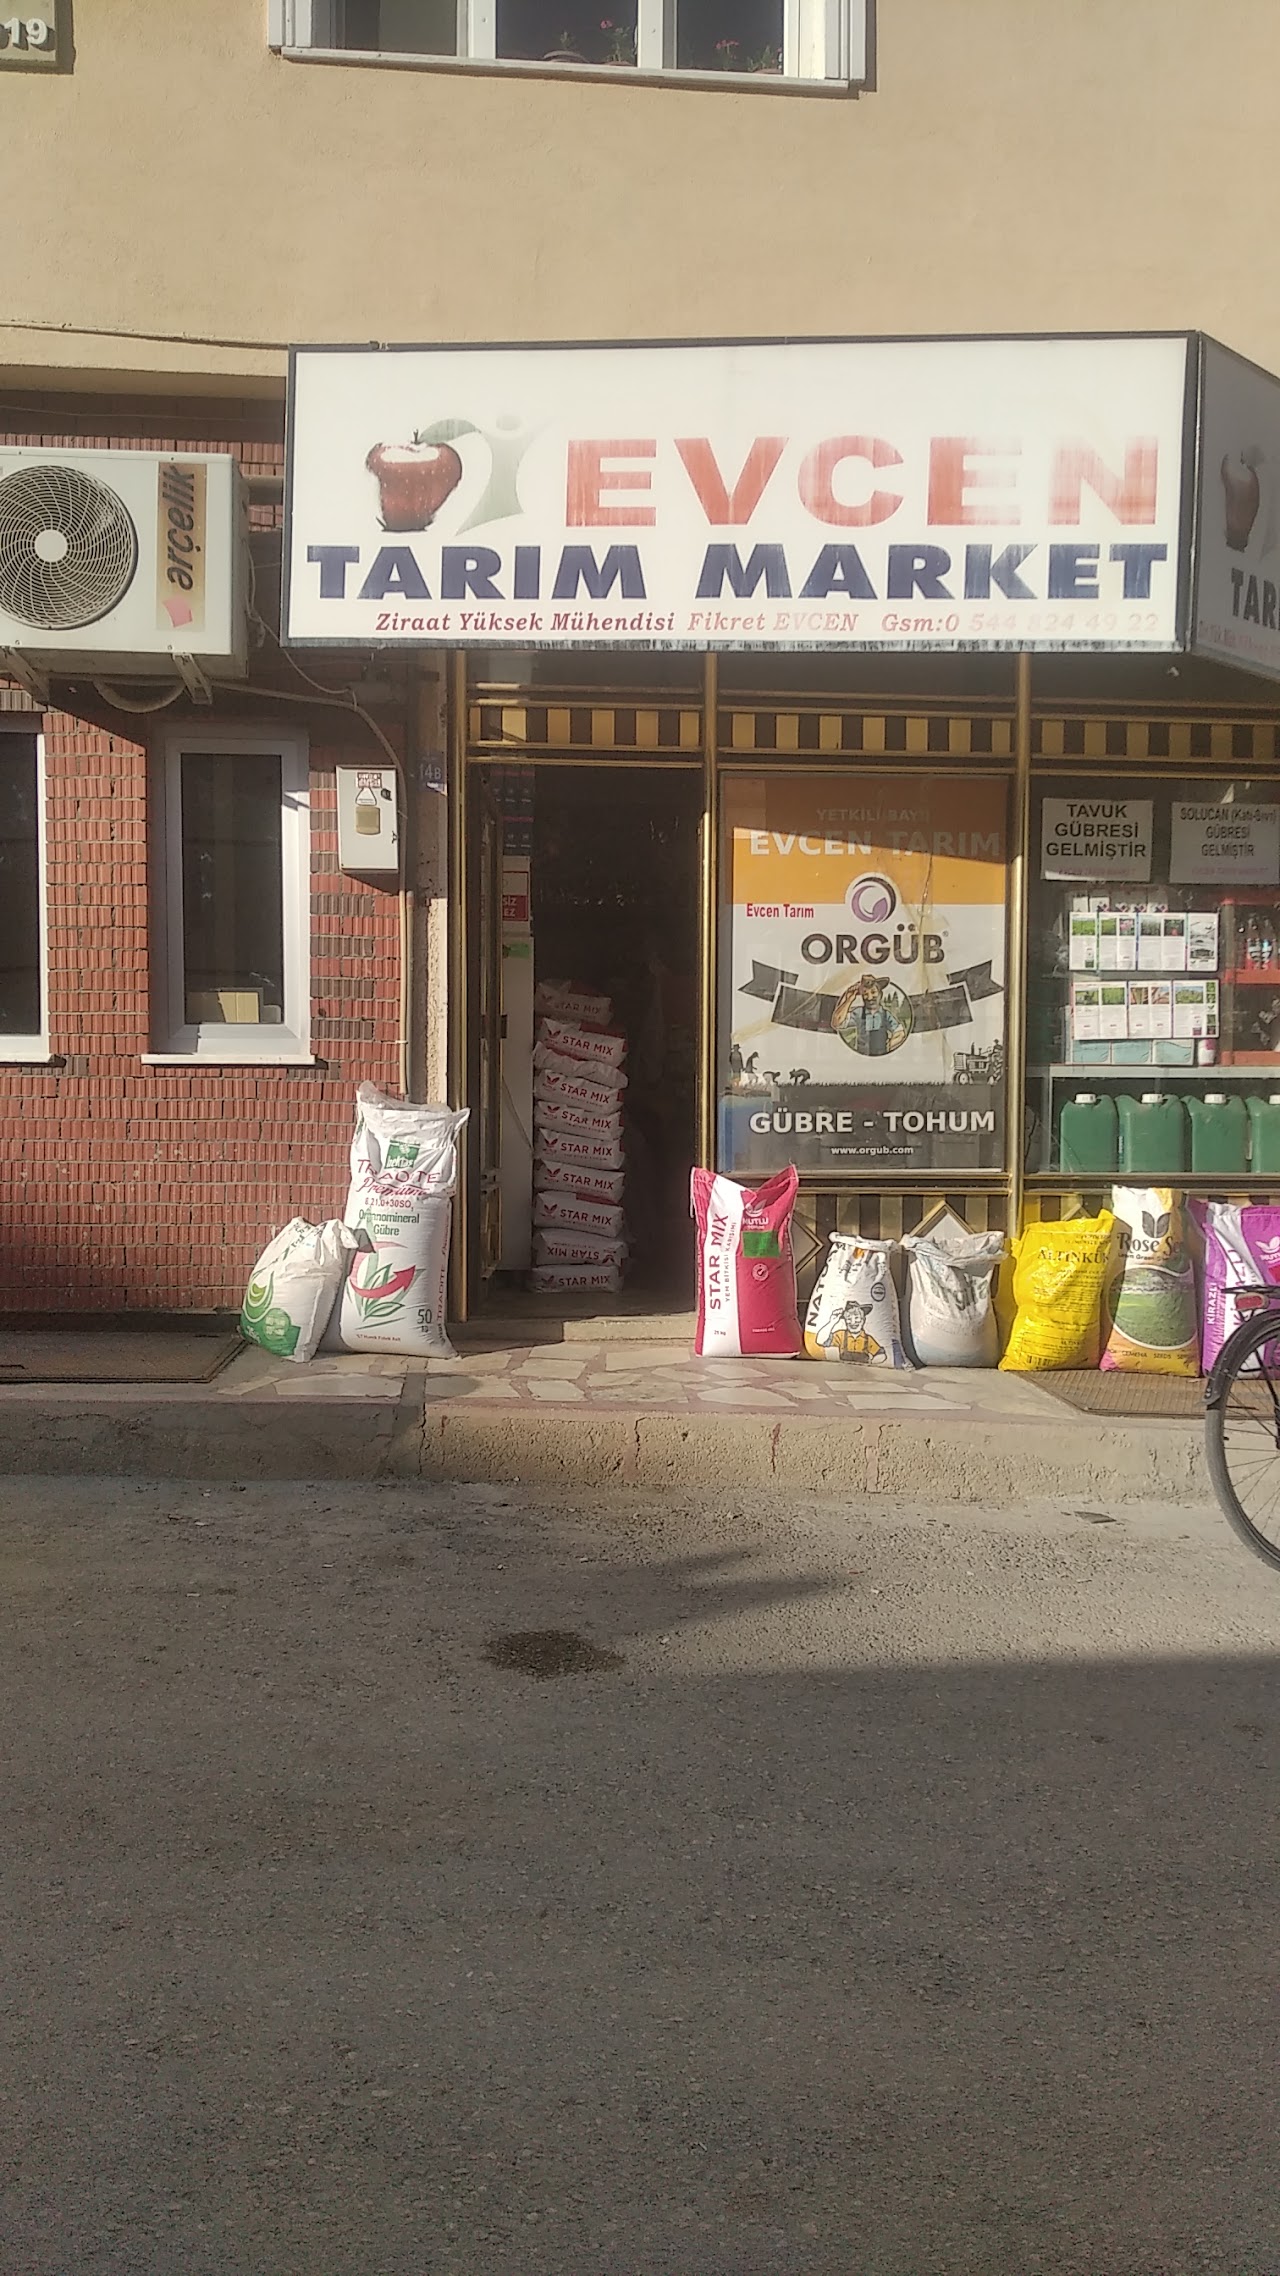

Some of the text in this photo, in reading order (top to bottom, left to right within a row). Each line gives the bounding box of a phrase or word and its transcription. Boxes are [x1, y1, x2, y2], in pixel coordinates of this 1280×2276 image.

[566, 435, 1158, 528] EVCEN
[162, 465, 201, 591] arçelik
[306, 543, 1169, 600] TARIM MARKET
[1231, 567, 1280, 632] TAR
[375, 613, 450, 631] Ziraat
[459, 611, 543, 631] Yüksek
[550, 611, 675, 632] Mühendisi
[687, 611, 765, 631] Fikret
[773, 613, 859, 632] EVCEN
[1066, 803, 1128, 818] TAVUK
[1180, 807, 1229, 821] SOLUCAN
[1054, 821, 1139, 838] GÜBRESİ
[750, 830, 1000, 856] EVCEN TARIM
[1046, 842, 1146, 860] GELMİŞTİR
[746, 903, 814, 918] Evcen Tarım
[800, 923, 945, 965] ORGÜB
[562, 1035, 614, 1056] STAR MIX
[560, 1083, 611, 1104] STAR MIX
[561, 1111, 612, 1129] STAR MIX
[750, 1107, 853, 1134] GÜBRE
[883, 1110, 995, 1132] TOHUM
[560, 1142, 613, 1156] STAR MIX
[831, 1145, 914, 1156] www.orgub.com
[563, 1173, 614, 1190] STAR MIX
[560, 1209, 612, 1225] STAR MIX
[373, 1224, 400, 1236] Gübre
[1116, 1232, 1160, 1253] Rose
[547, 1246, 600, 1260] STAR MIX
[709, 1213, 729, 1310] STAR MIX
[558, 1275, 611, 1287] STAR MIX
[417, 1309, 432, 1324] 50
